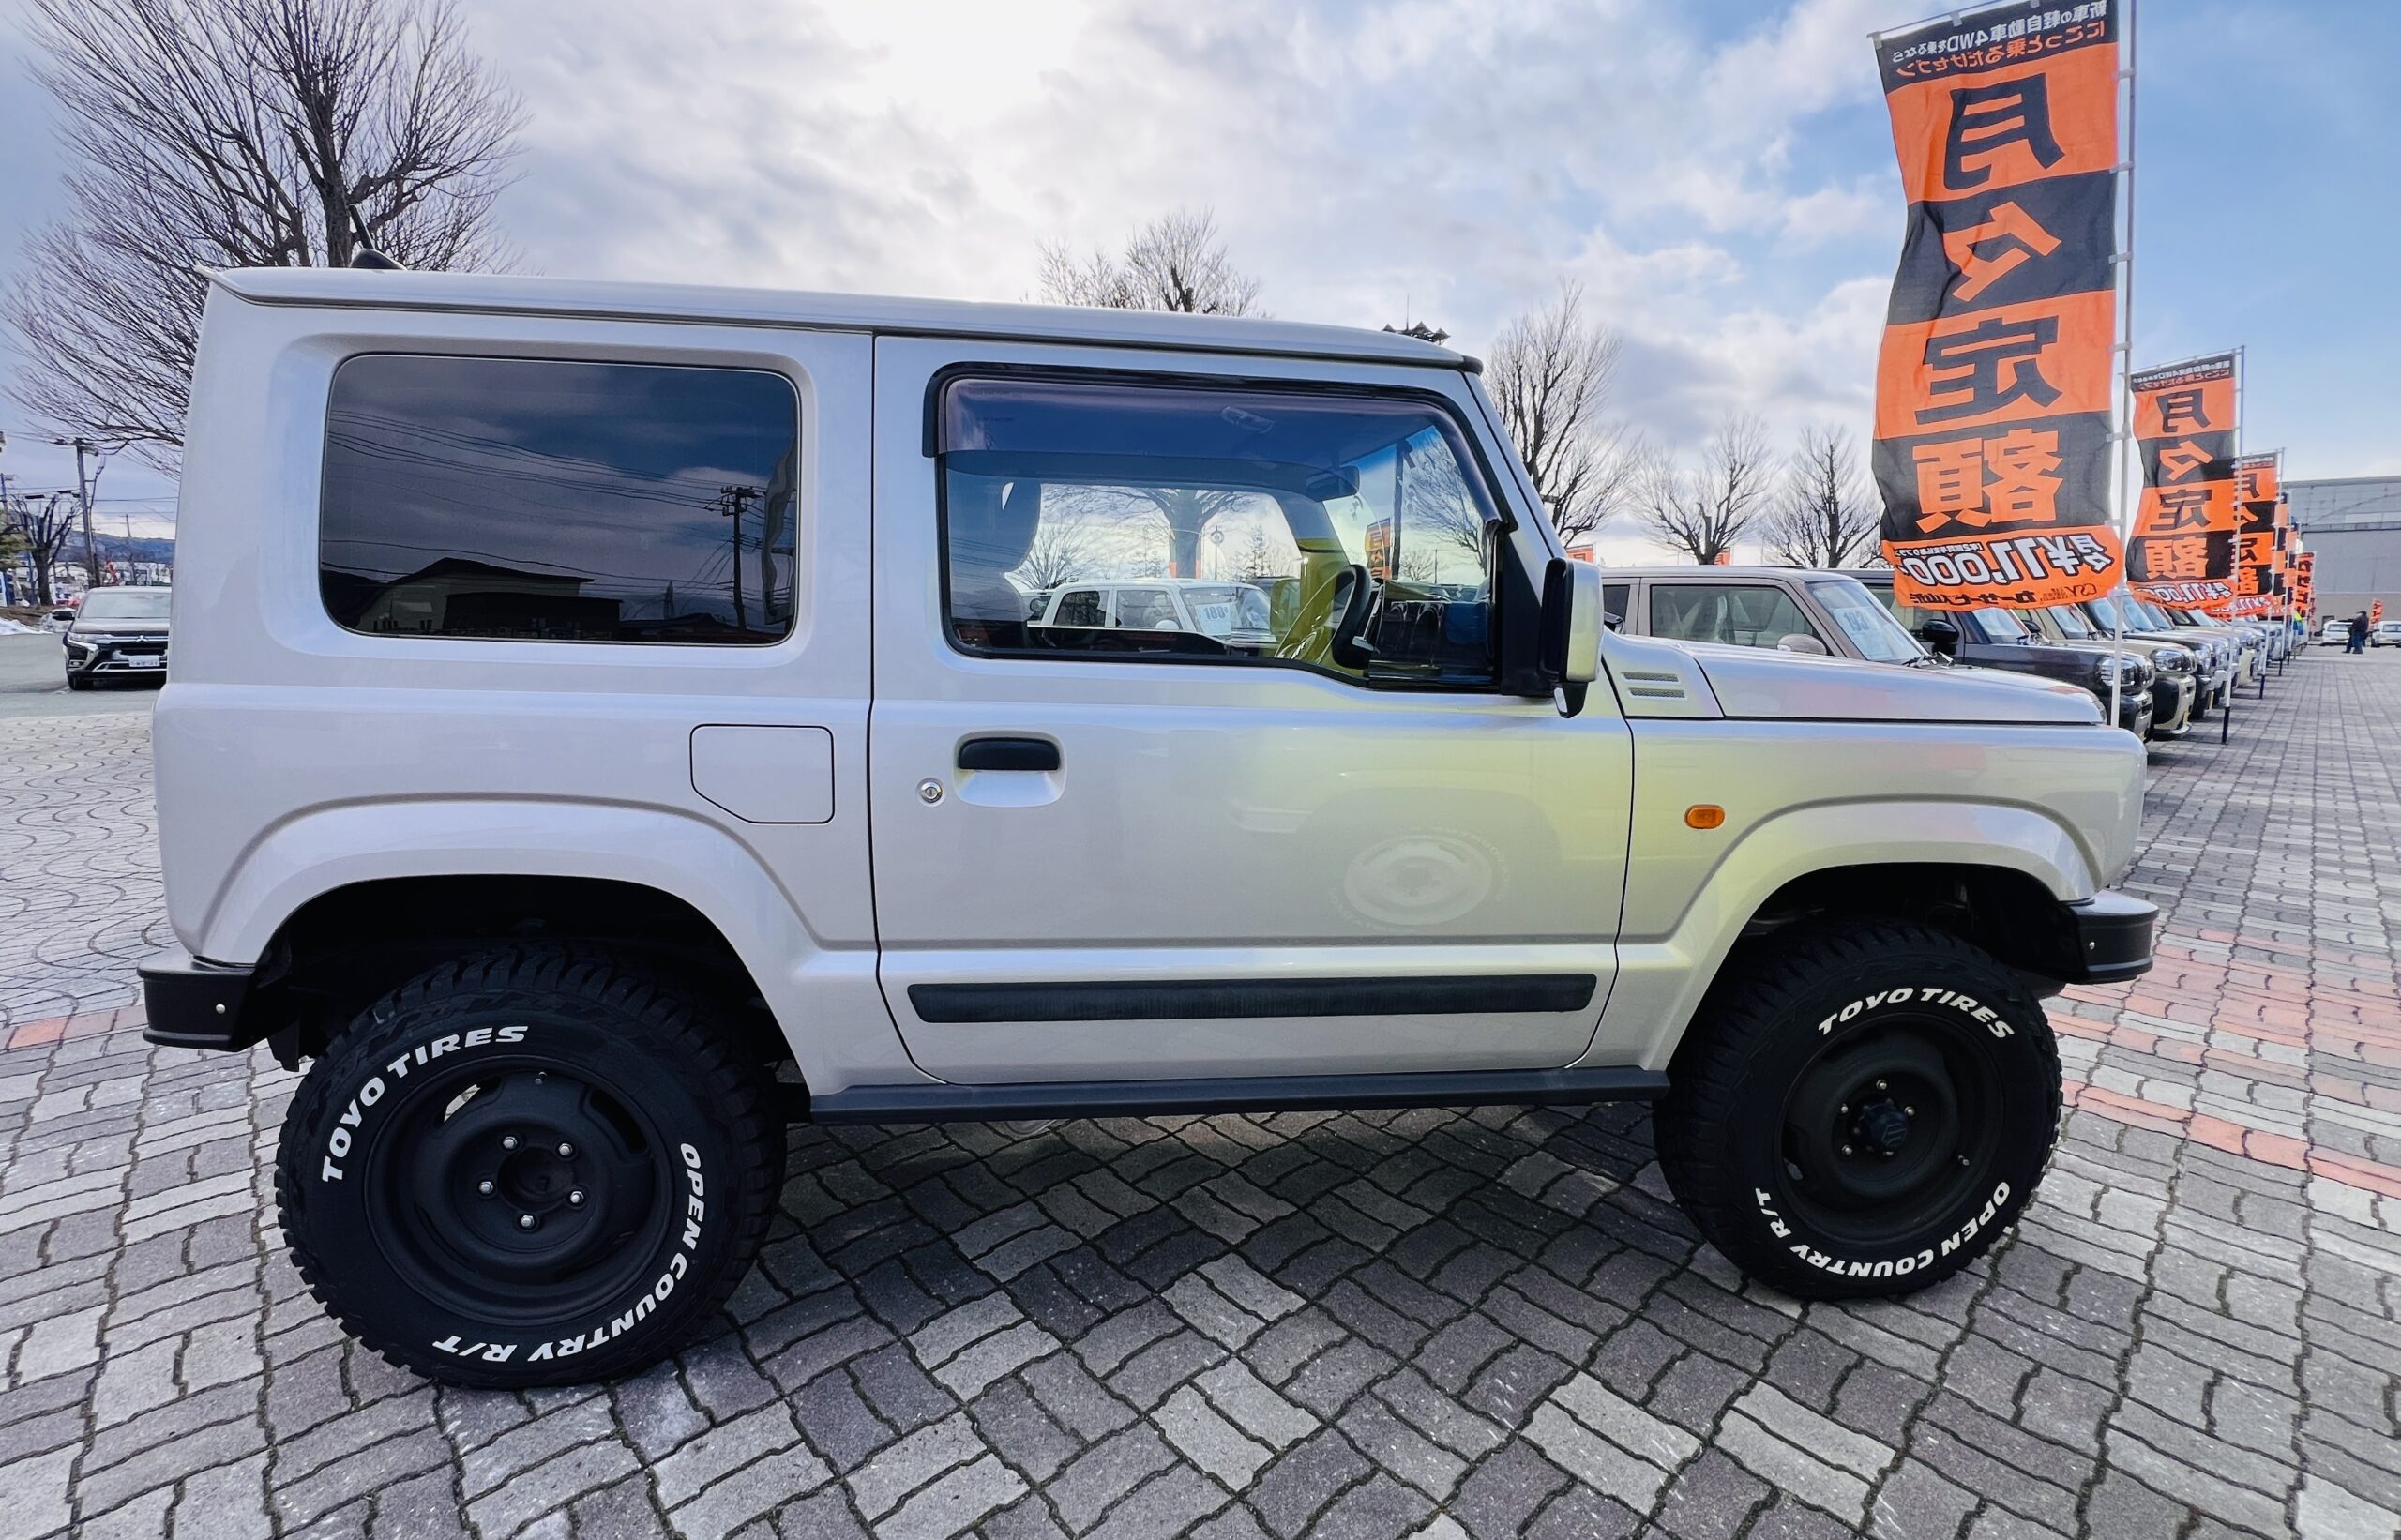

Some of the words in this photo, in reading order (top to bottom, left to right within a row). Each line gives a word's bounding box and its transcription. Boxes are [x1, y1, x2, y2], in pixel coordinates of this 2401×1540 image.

[1818, 987, 1914, 1035] TOYO
[1920, 987, 2015, 1038] TIRES
[322, 1076, 385, 1183] TOYO
[386, 1025, 529, 1079] TIRES
[680, 1142, 705, 1250] OPEN
[1755, 1187, 1792, 1238] R/T
[1941, 1182, 2010, 1258] OPEN
[1789, 1244, 1934, 1277] COUNTRY
[527, 1252, 687, 1362] COUNTRY
[432, 1335, 518, 1363] R/T
